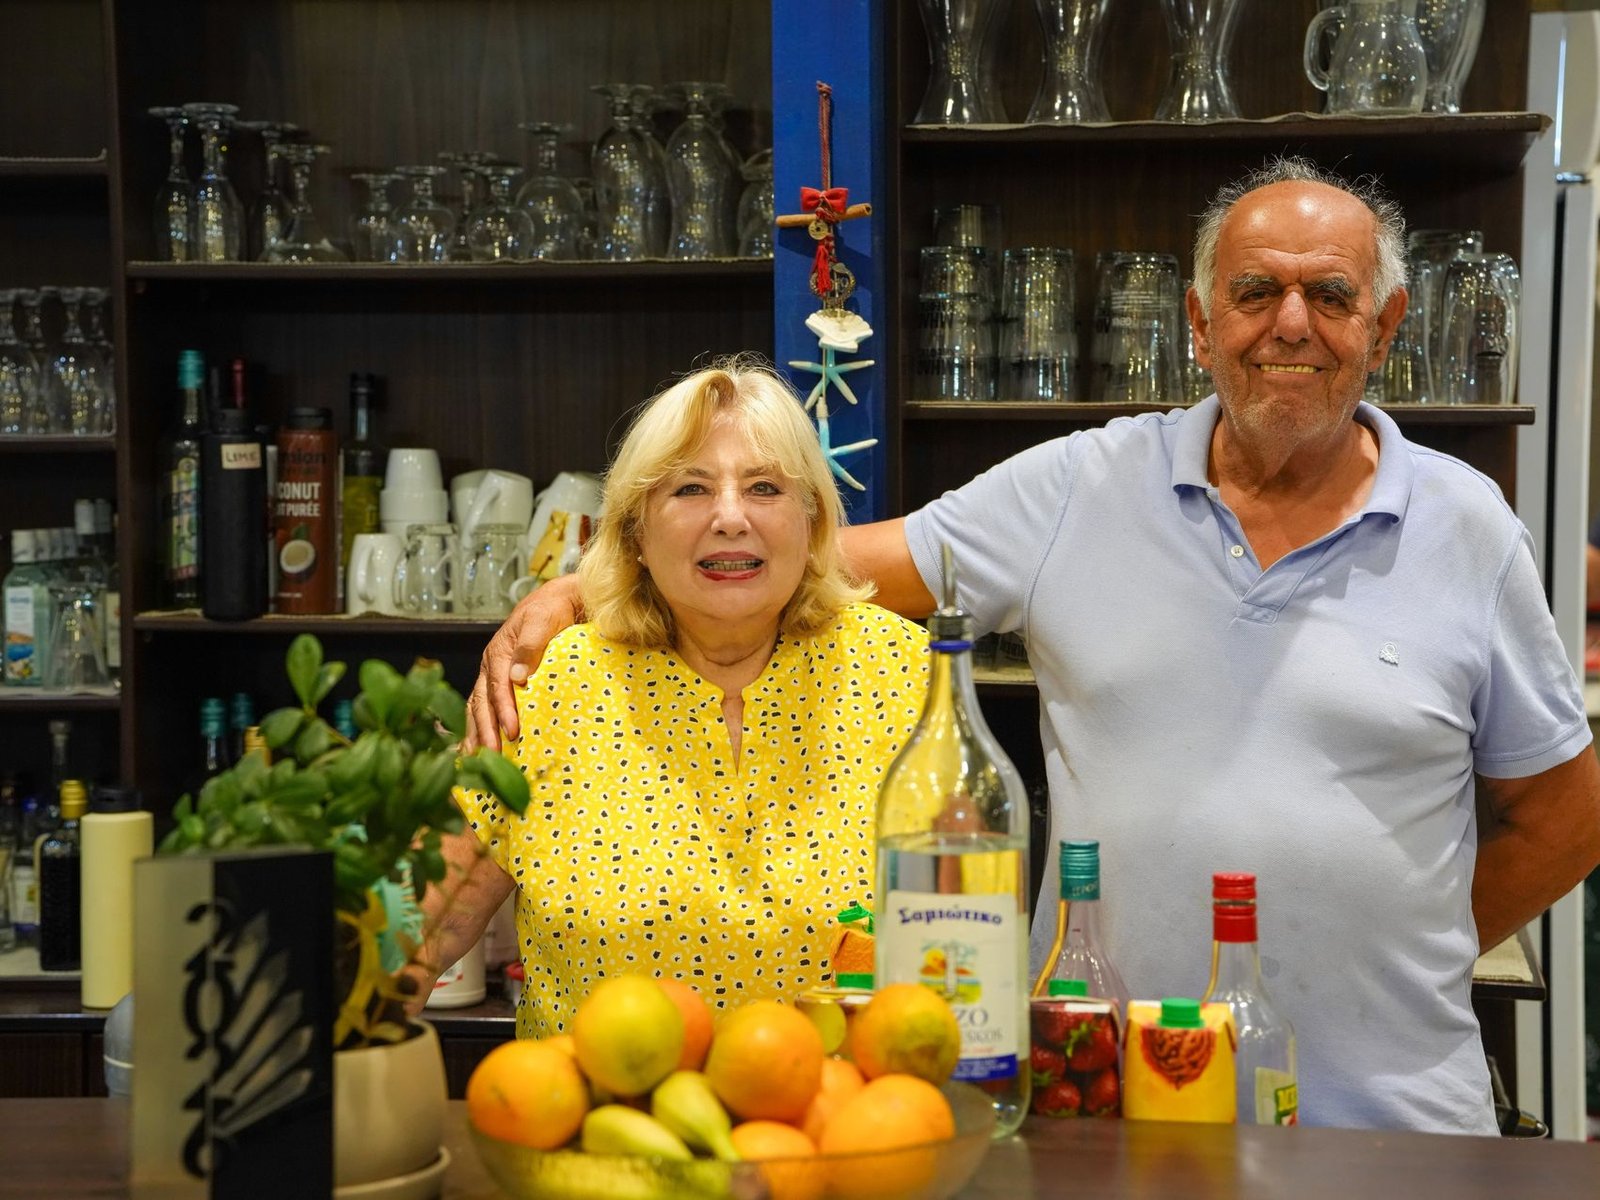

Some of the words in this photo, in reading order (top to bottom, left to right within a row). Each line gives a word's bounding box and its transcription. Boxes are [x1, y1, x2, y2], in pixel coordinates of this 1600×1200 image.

[225, 449, 258, 463] LIME
[276, 482, 321, 499] CONUT
[286, 501, 321, 516] PURÉE
